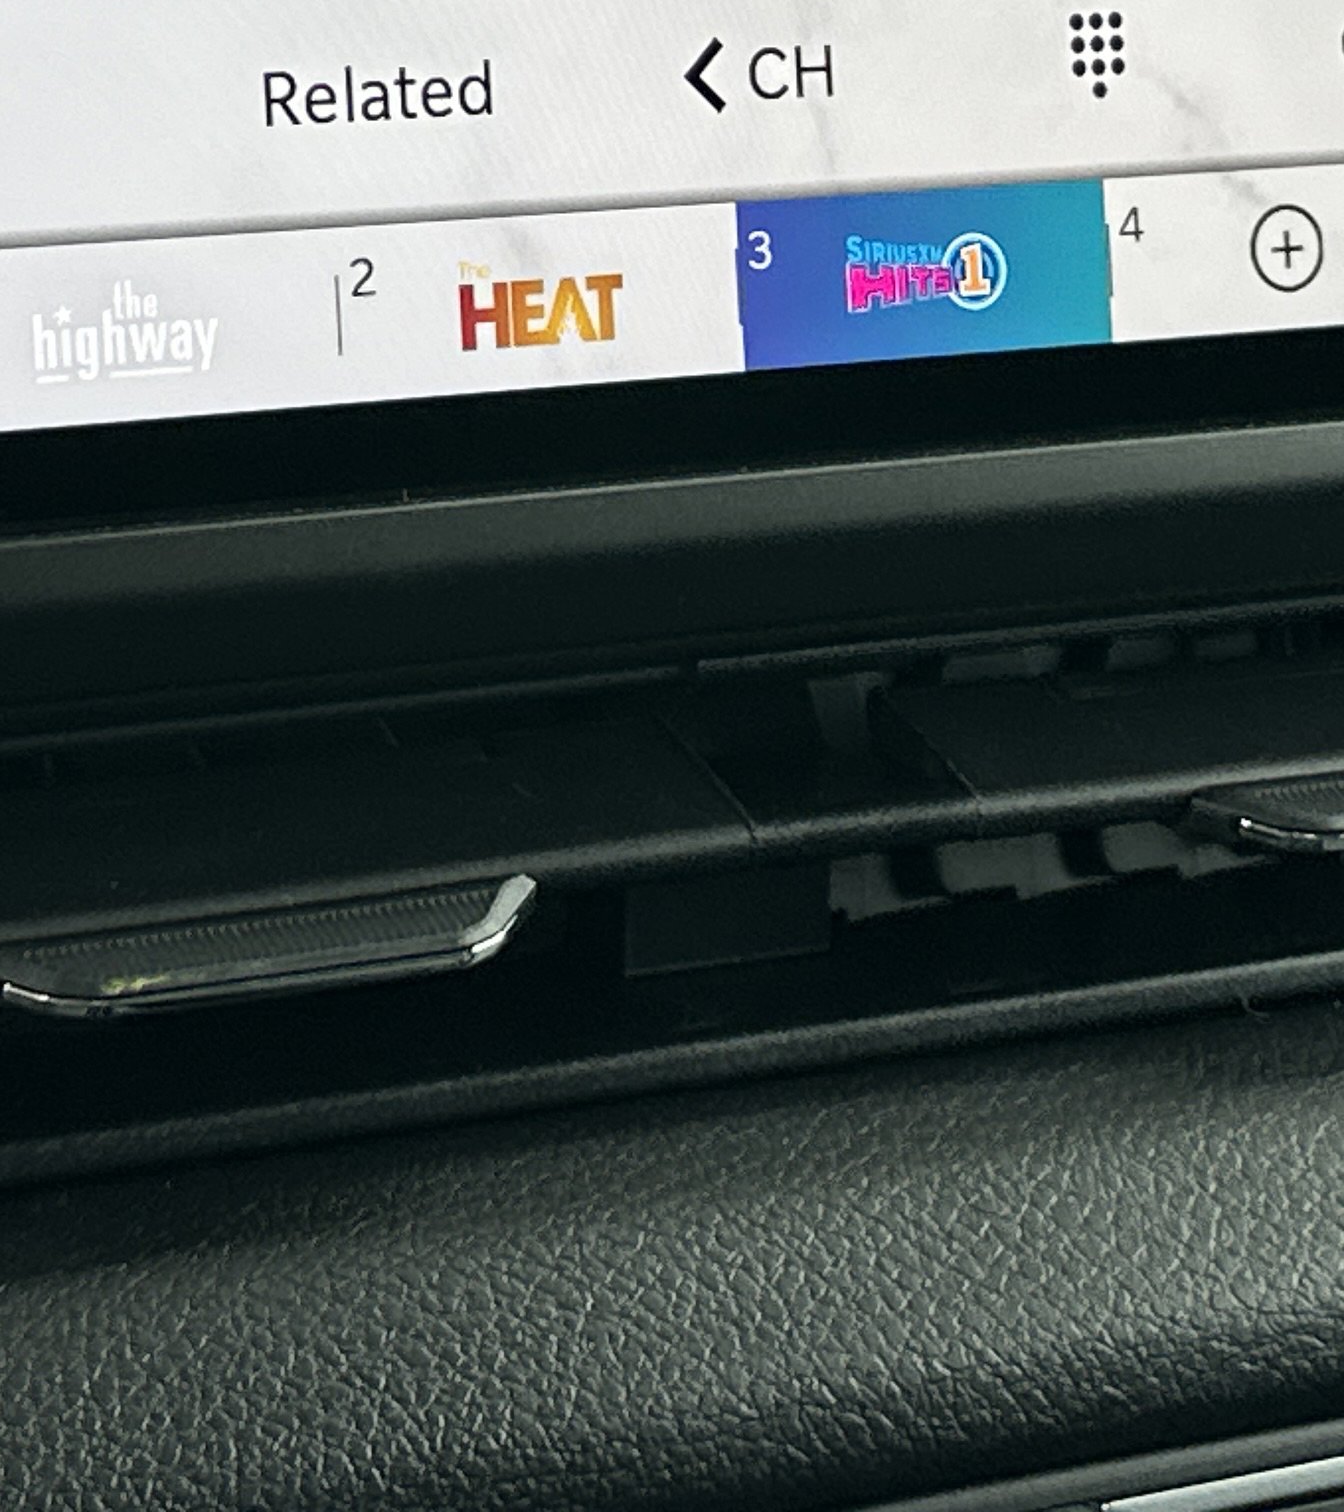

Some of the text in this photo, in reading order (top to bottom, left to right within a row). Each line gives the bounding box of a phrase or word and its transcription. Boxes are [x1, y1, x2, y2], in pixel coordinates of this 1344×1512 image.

[263, 59, 493, 127] Related
[748, 44, 834, 100] CH
[1118, 206, 1144, 242] 4
[748, 230, 772, 270] 3
[113, 279, 158, 320] the
[350, 257, 376, 298] 2
[845, 263, 954, 313] HITS
[458, 273, 623, 351] HEAT
[31, 306, 220, 380] highway
